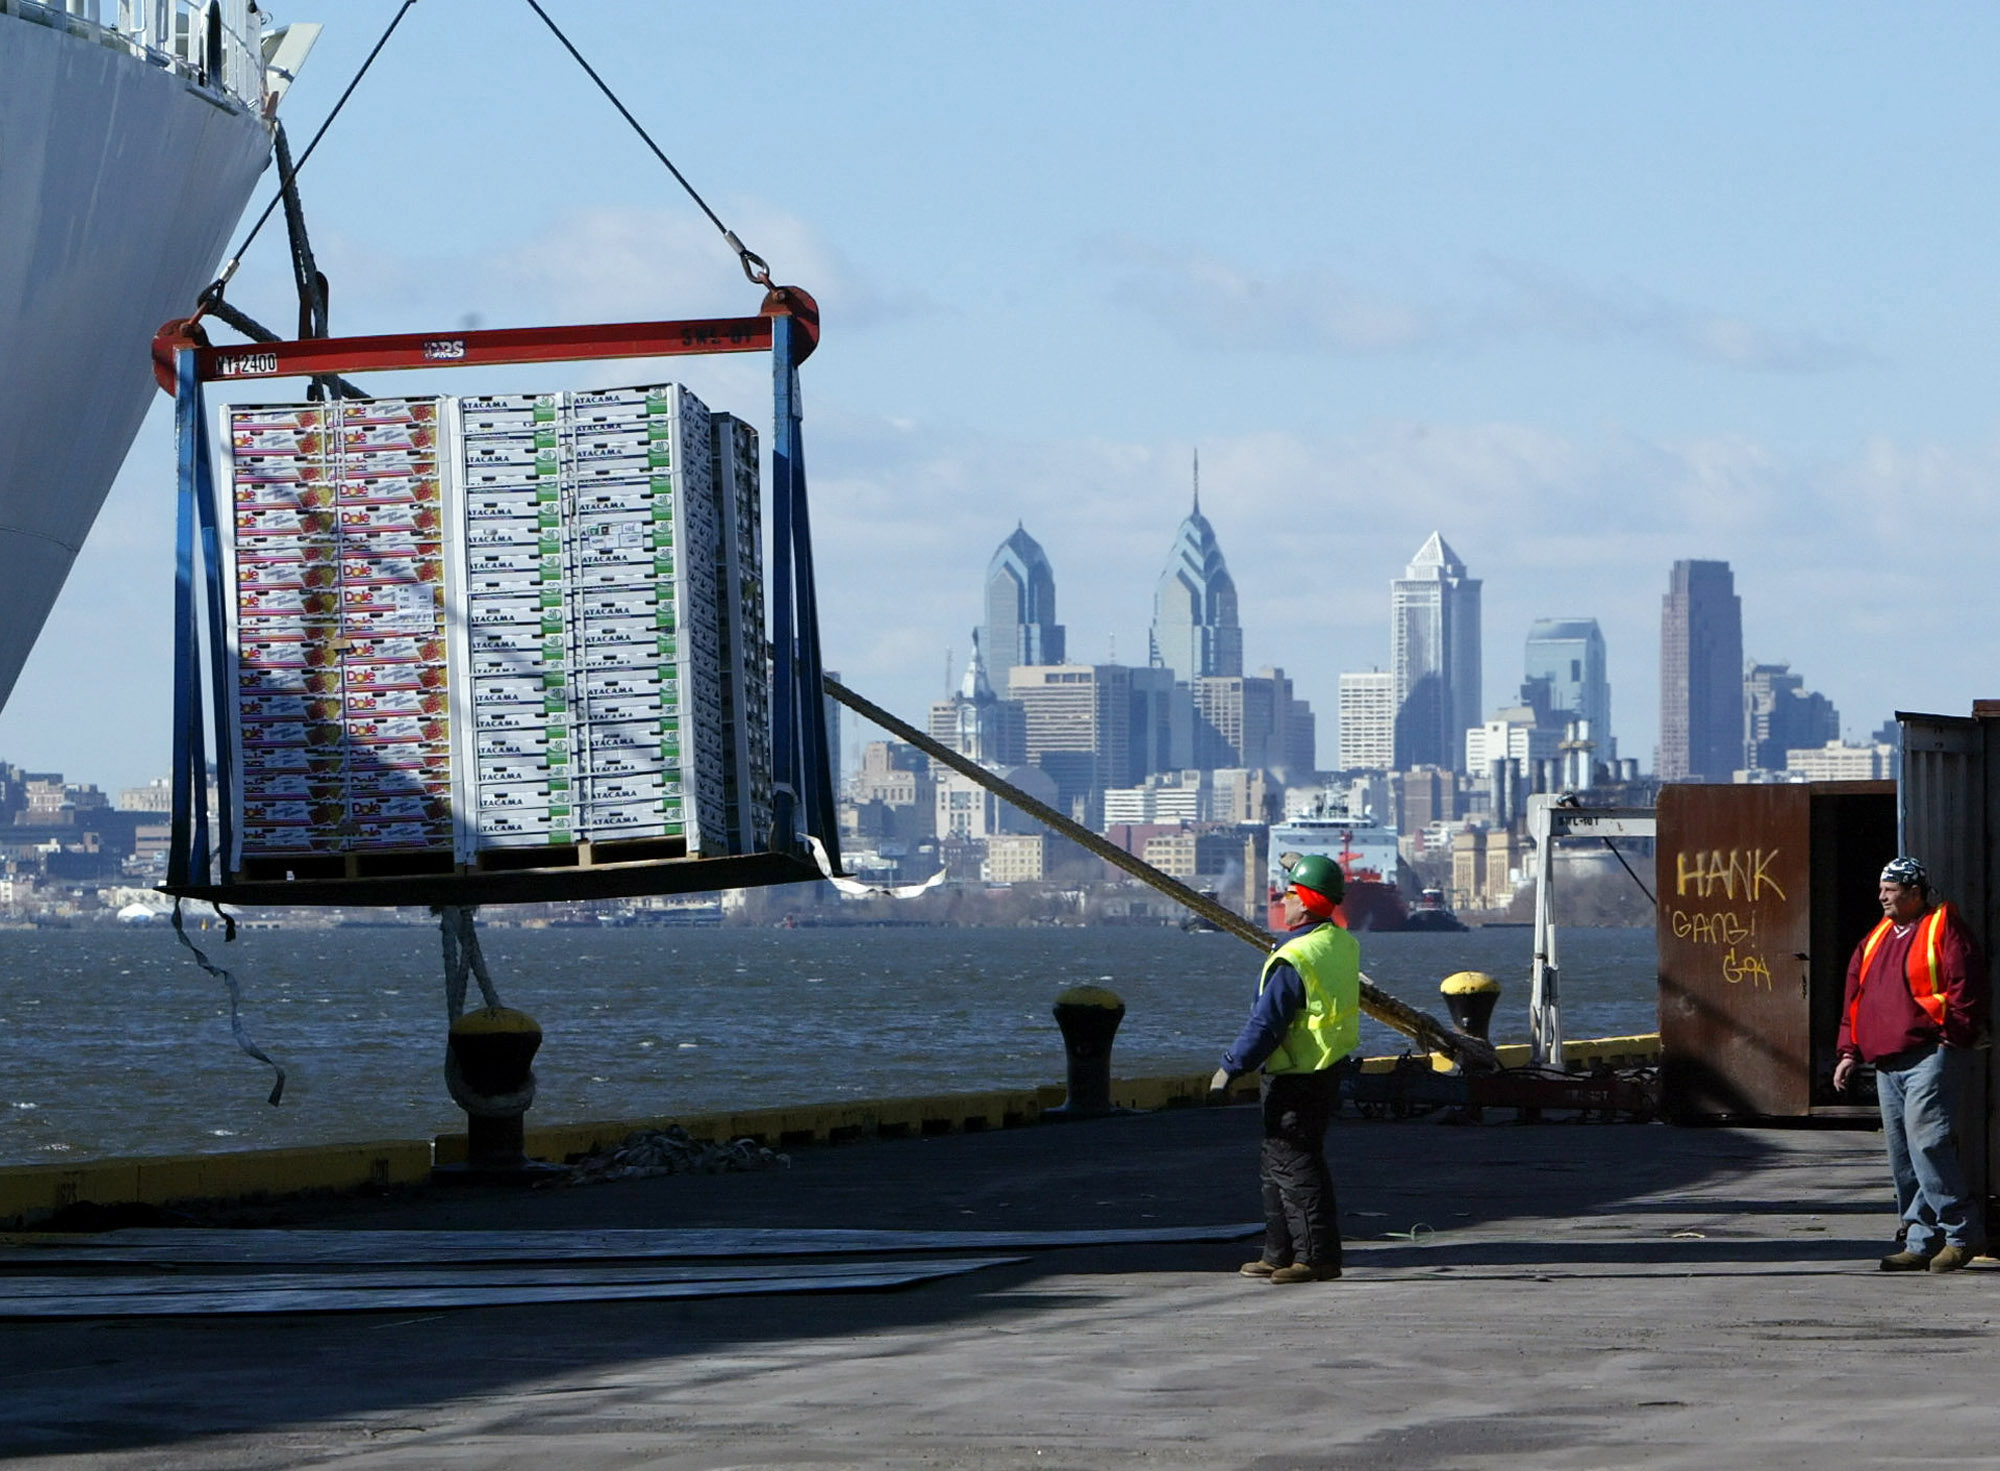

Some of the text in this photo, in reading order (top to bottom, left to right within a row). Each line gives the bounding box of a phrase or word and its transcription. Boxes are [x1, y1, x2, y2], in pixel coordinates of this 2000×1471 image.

[242, 353, 277, 373] 2400
[574, 395, 620, 404] ATACAMA
[577, 449, 623, 457] ATACAMA
[340, 483, 369, 496] Dole
[580, 502, 626, 510] ATACAMA
[341, 511, 370, 523] Dole
[343, 563, 372, 577] Dole
[345, 590, 374, 604] Dole
[584, 607, 630, 616] ATACAMA
[585, 634, 632, 643] ATACAMA
[347, 670, 376, 683] Dole
[588, 687, 634, 695] ATACAMA
[348, 696, 377, 709] Dole
[349, 723, 378, 736] Dole
[590, 738, 635, 747] ATACAMA
[592, 790, 637, 799] ATACAMA
[593, 817, 638, 825] ATACAMA
[1677, 849, 1786, 902] HANK
